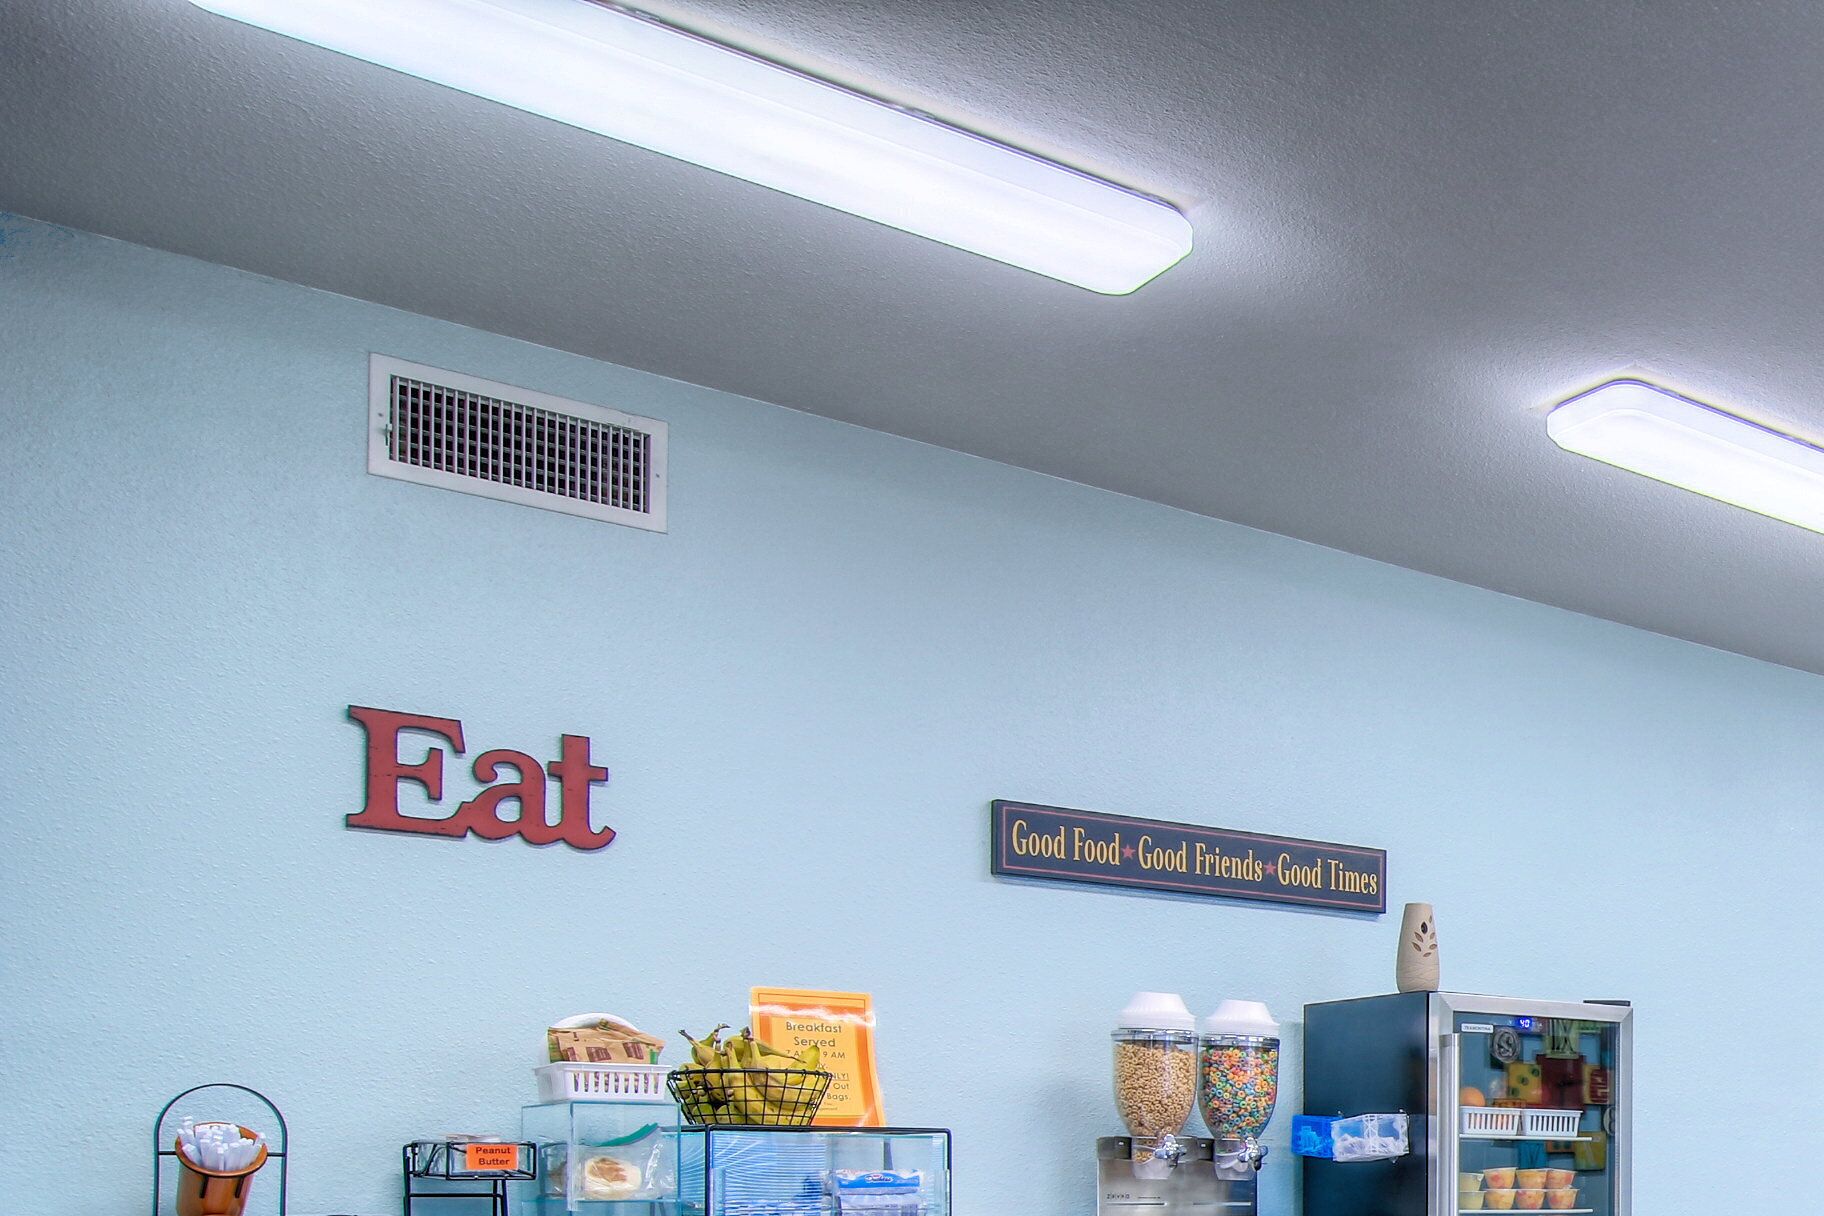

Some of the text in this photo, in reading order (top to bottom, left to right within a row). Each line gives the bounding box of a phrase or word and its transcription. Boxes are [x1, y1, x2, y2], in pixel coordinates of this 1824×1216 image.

[346, 704, 616, 850] Eat
[1012, 819, 1377, 895] Good Food Good Friends Good Times
[786, 1021, 842, 1033] Breakfast
[793, 1036, 836, 1047] Served
[475, 1146, 511, 1154] Peanut
